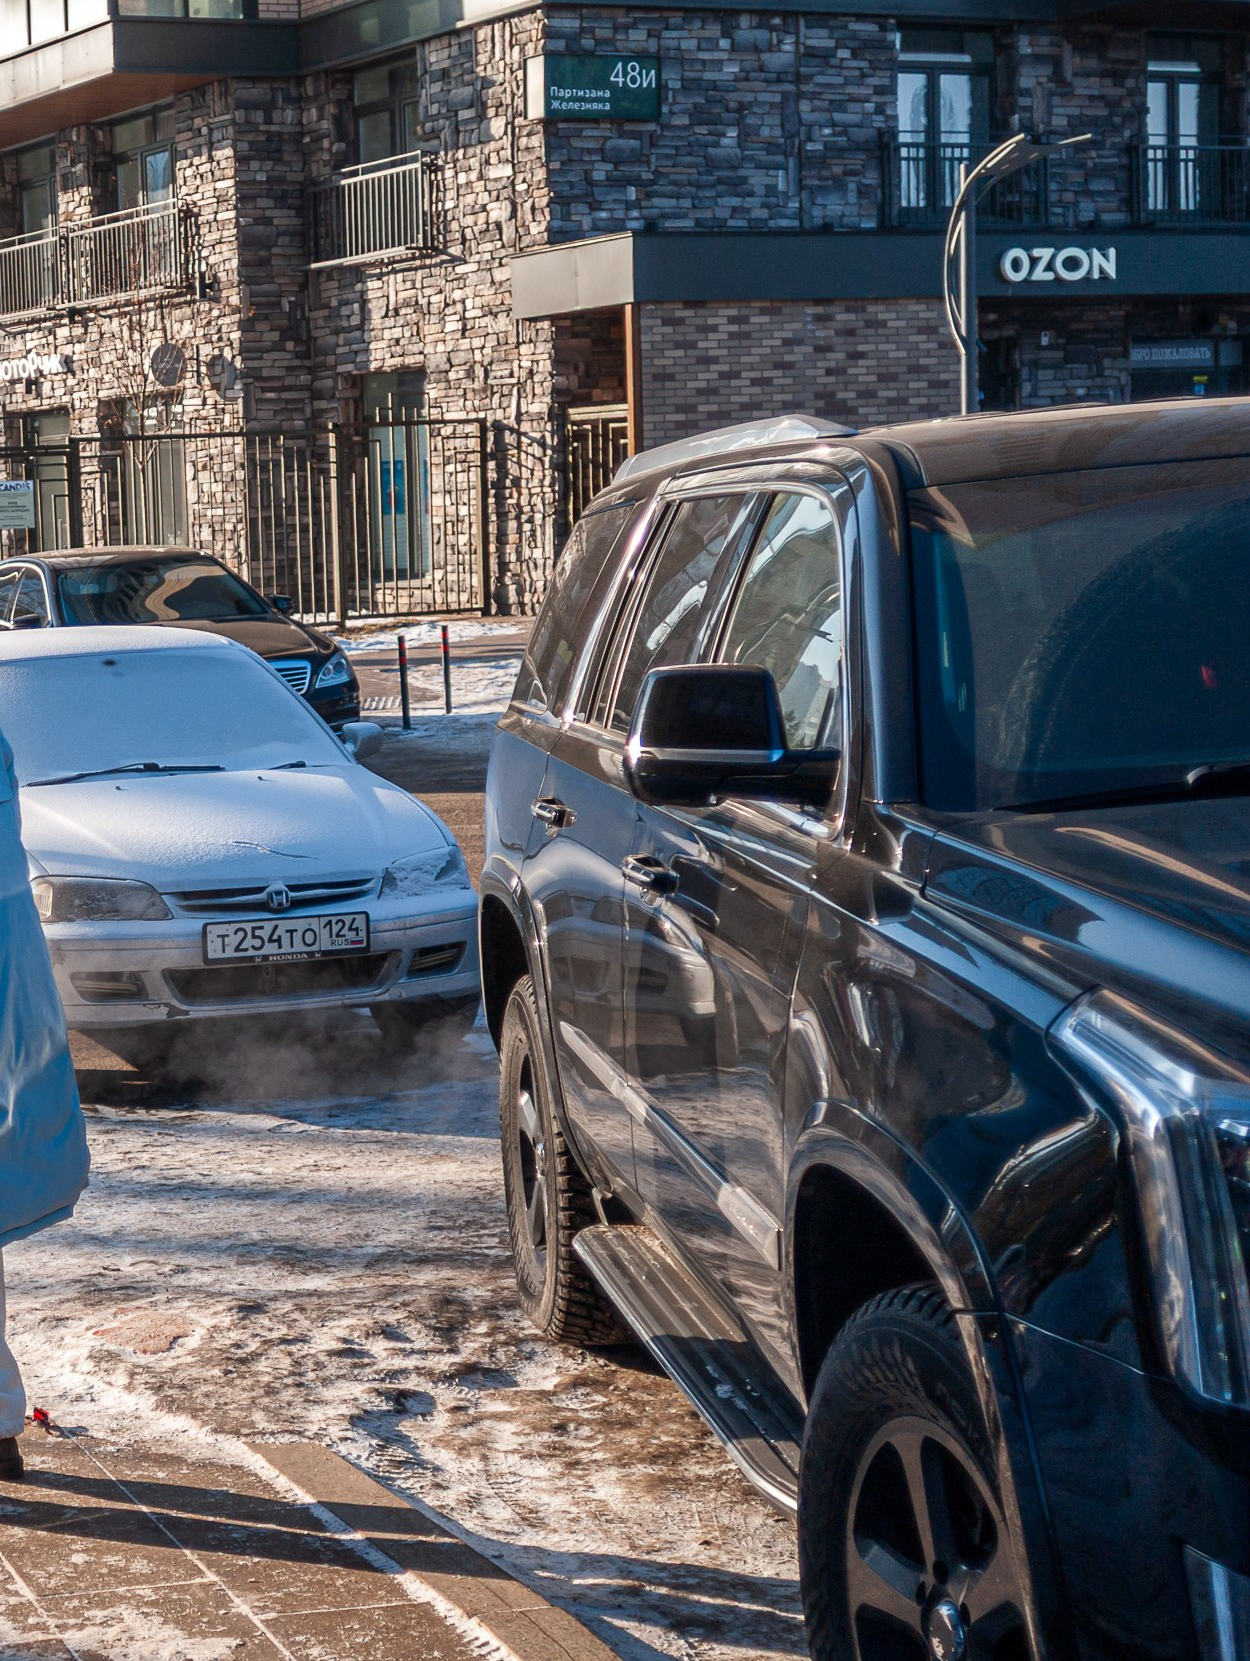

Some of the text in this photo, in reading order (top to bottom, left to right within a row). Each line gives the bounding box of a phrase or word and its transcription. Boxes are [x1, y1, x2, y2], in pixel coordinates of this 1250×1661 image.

[550, 86, 610, 99] Партизана
[550, 99, 611, 110] Железняка
[1000, 246, 1116, 282] OZON
[1152, 346, 1211, 361] ПОЖАЛОВАТЬ
[323, 917, 360, 939] 124
[331, 938, 350, 947] RUS
[269, 953, 308, 961] HONDA
